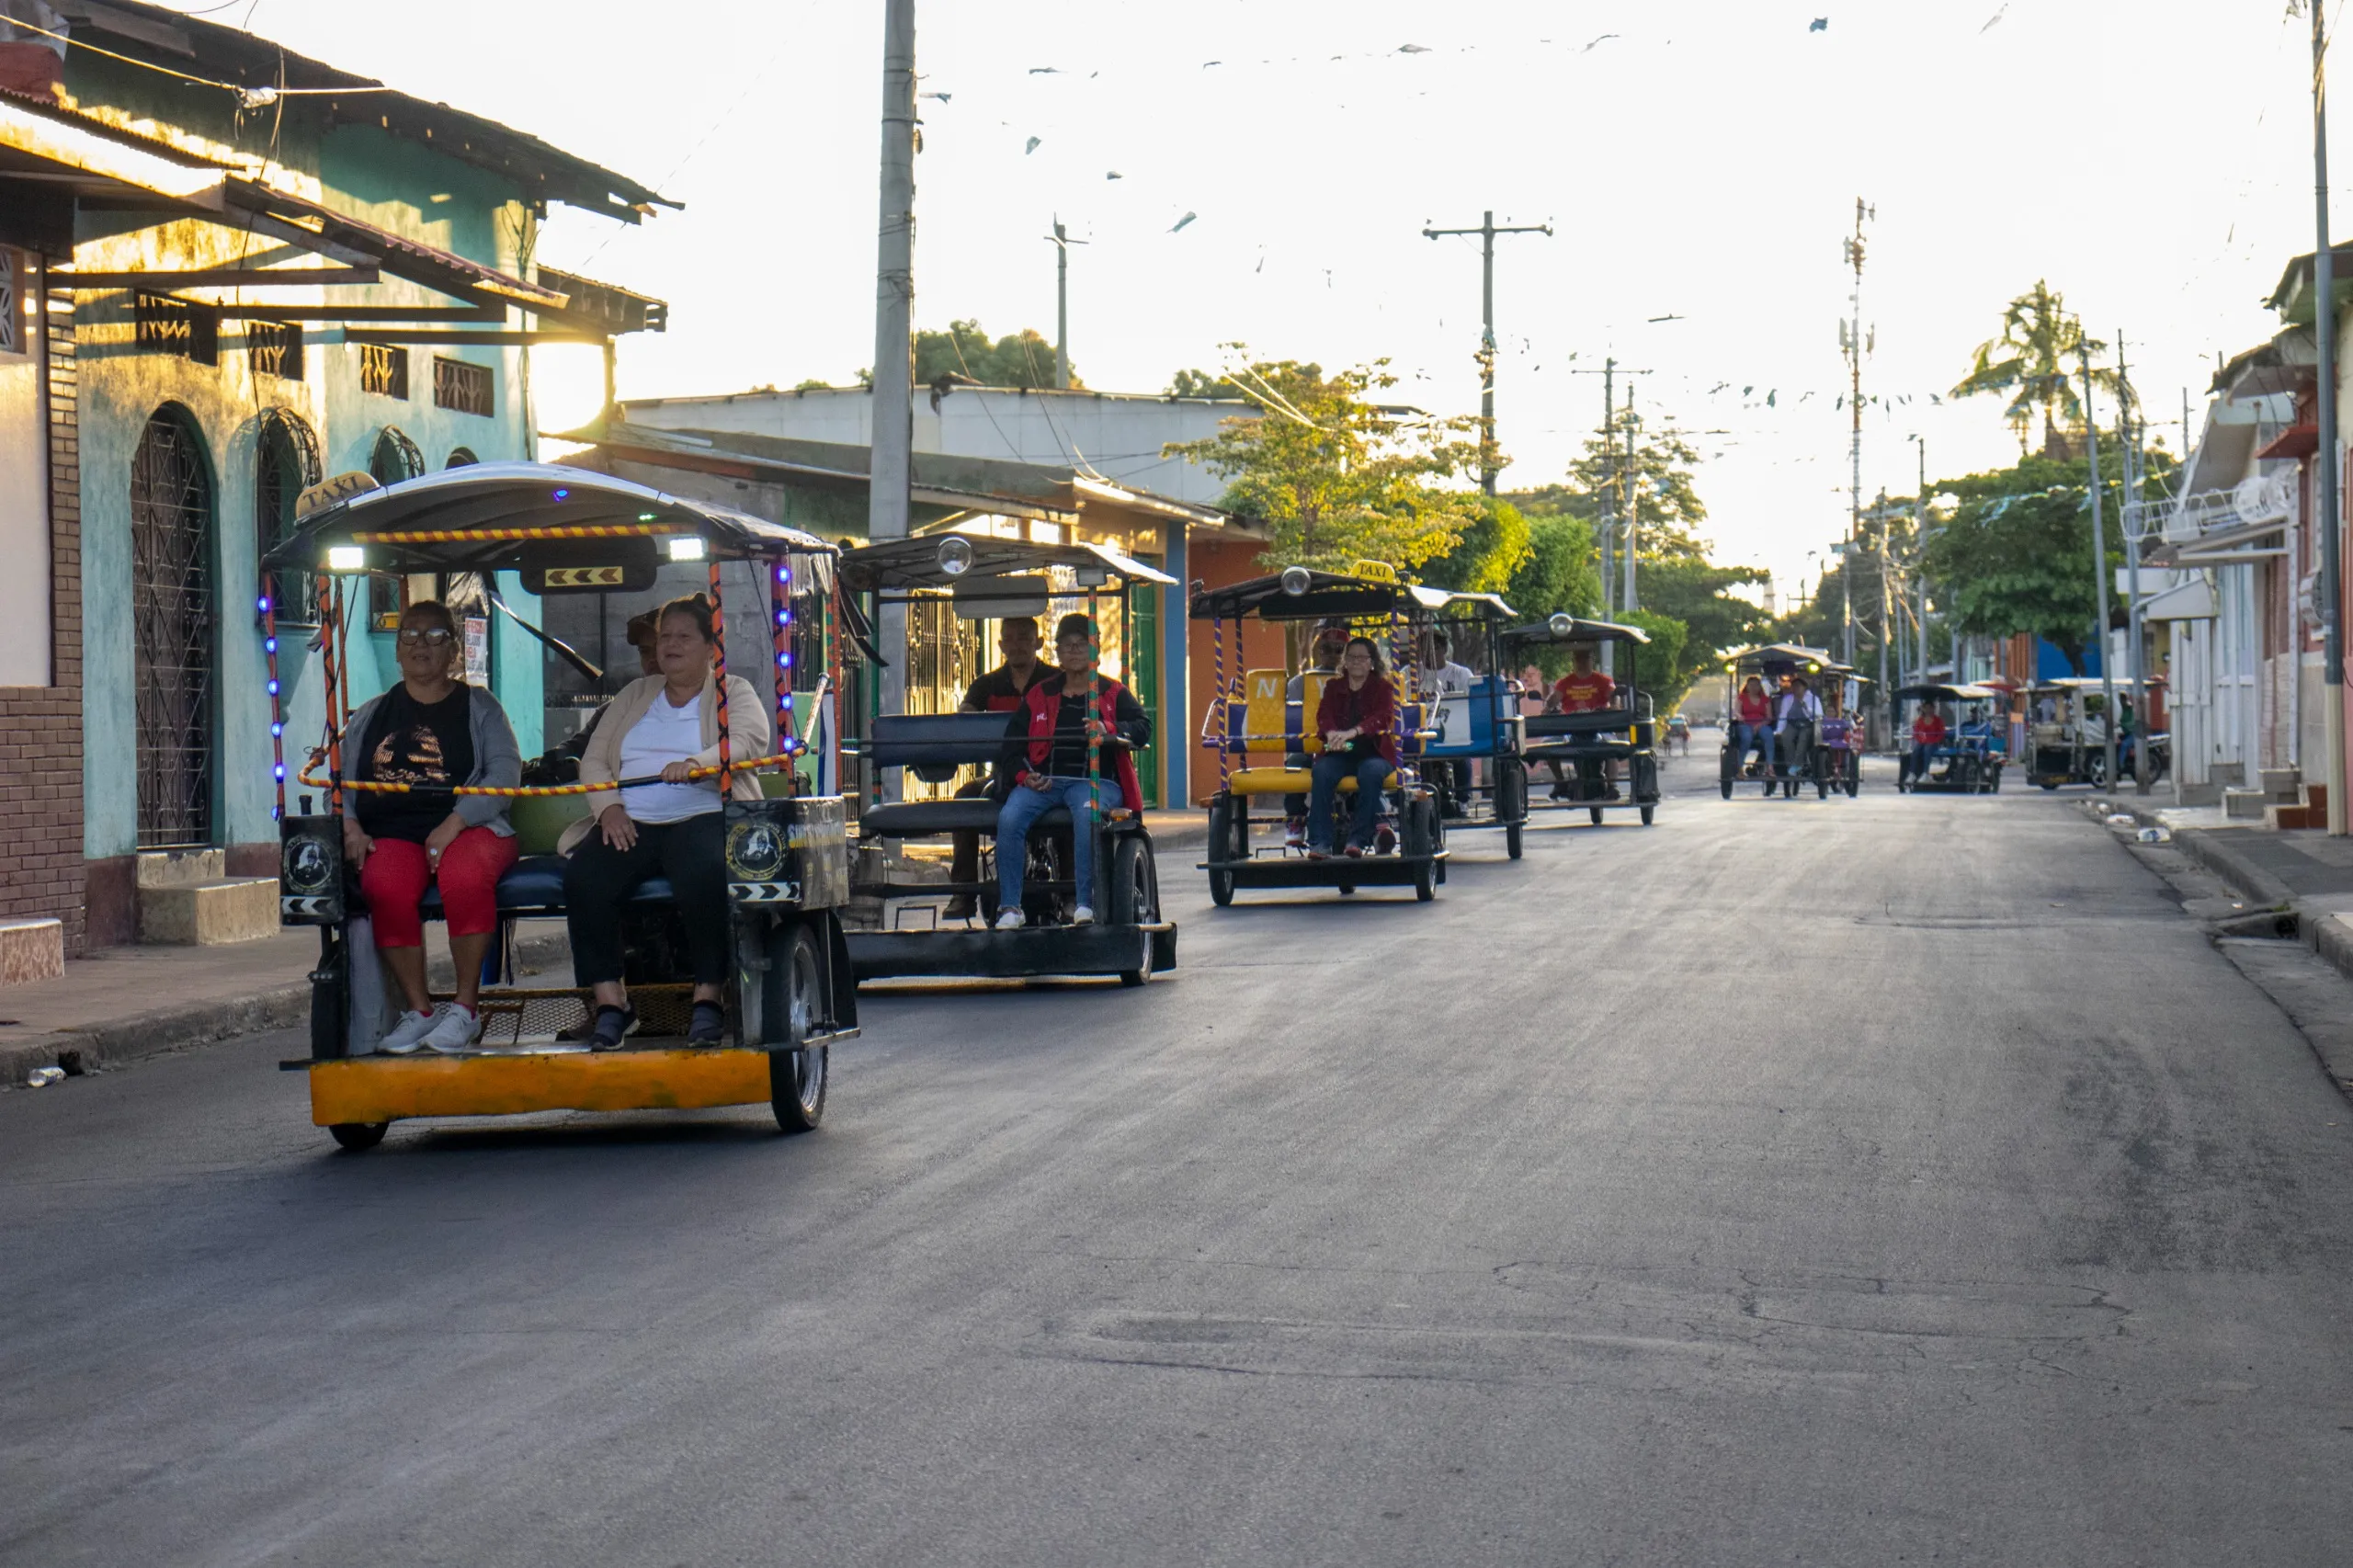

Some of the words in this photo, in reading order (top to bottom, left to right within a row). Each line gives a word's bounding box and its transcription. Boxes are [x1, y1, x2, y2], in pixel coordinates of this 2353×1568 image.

[302, 475, 359, 507] TAXI
[1358, 562, 1388, 578] TAXI
[1256, 677, 1278, 699] N
